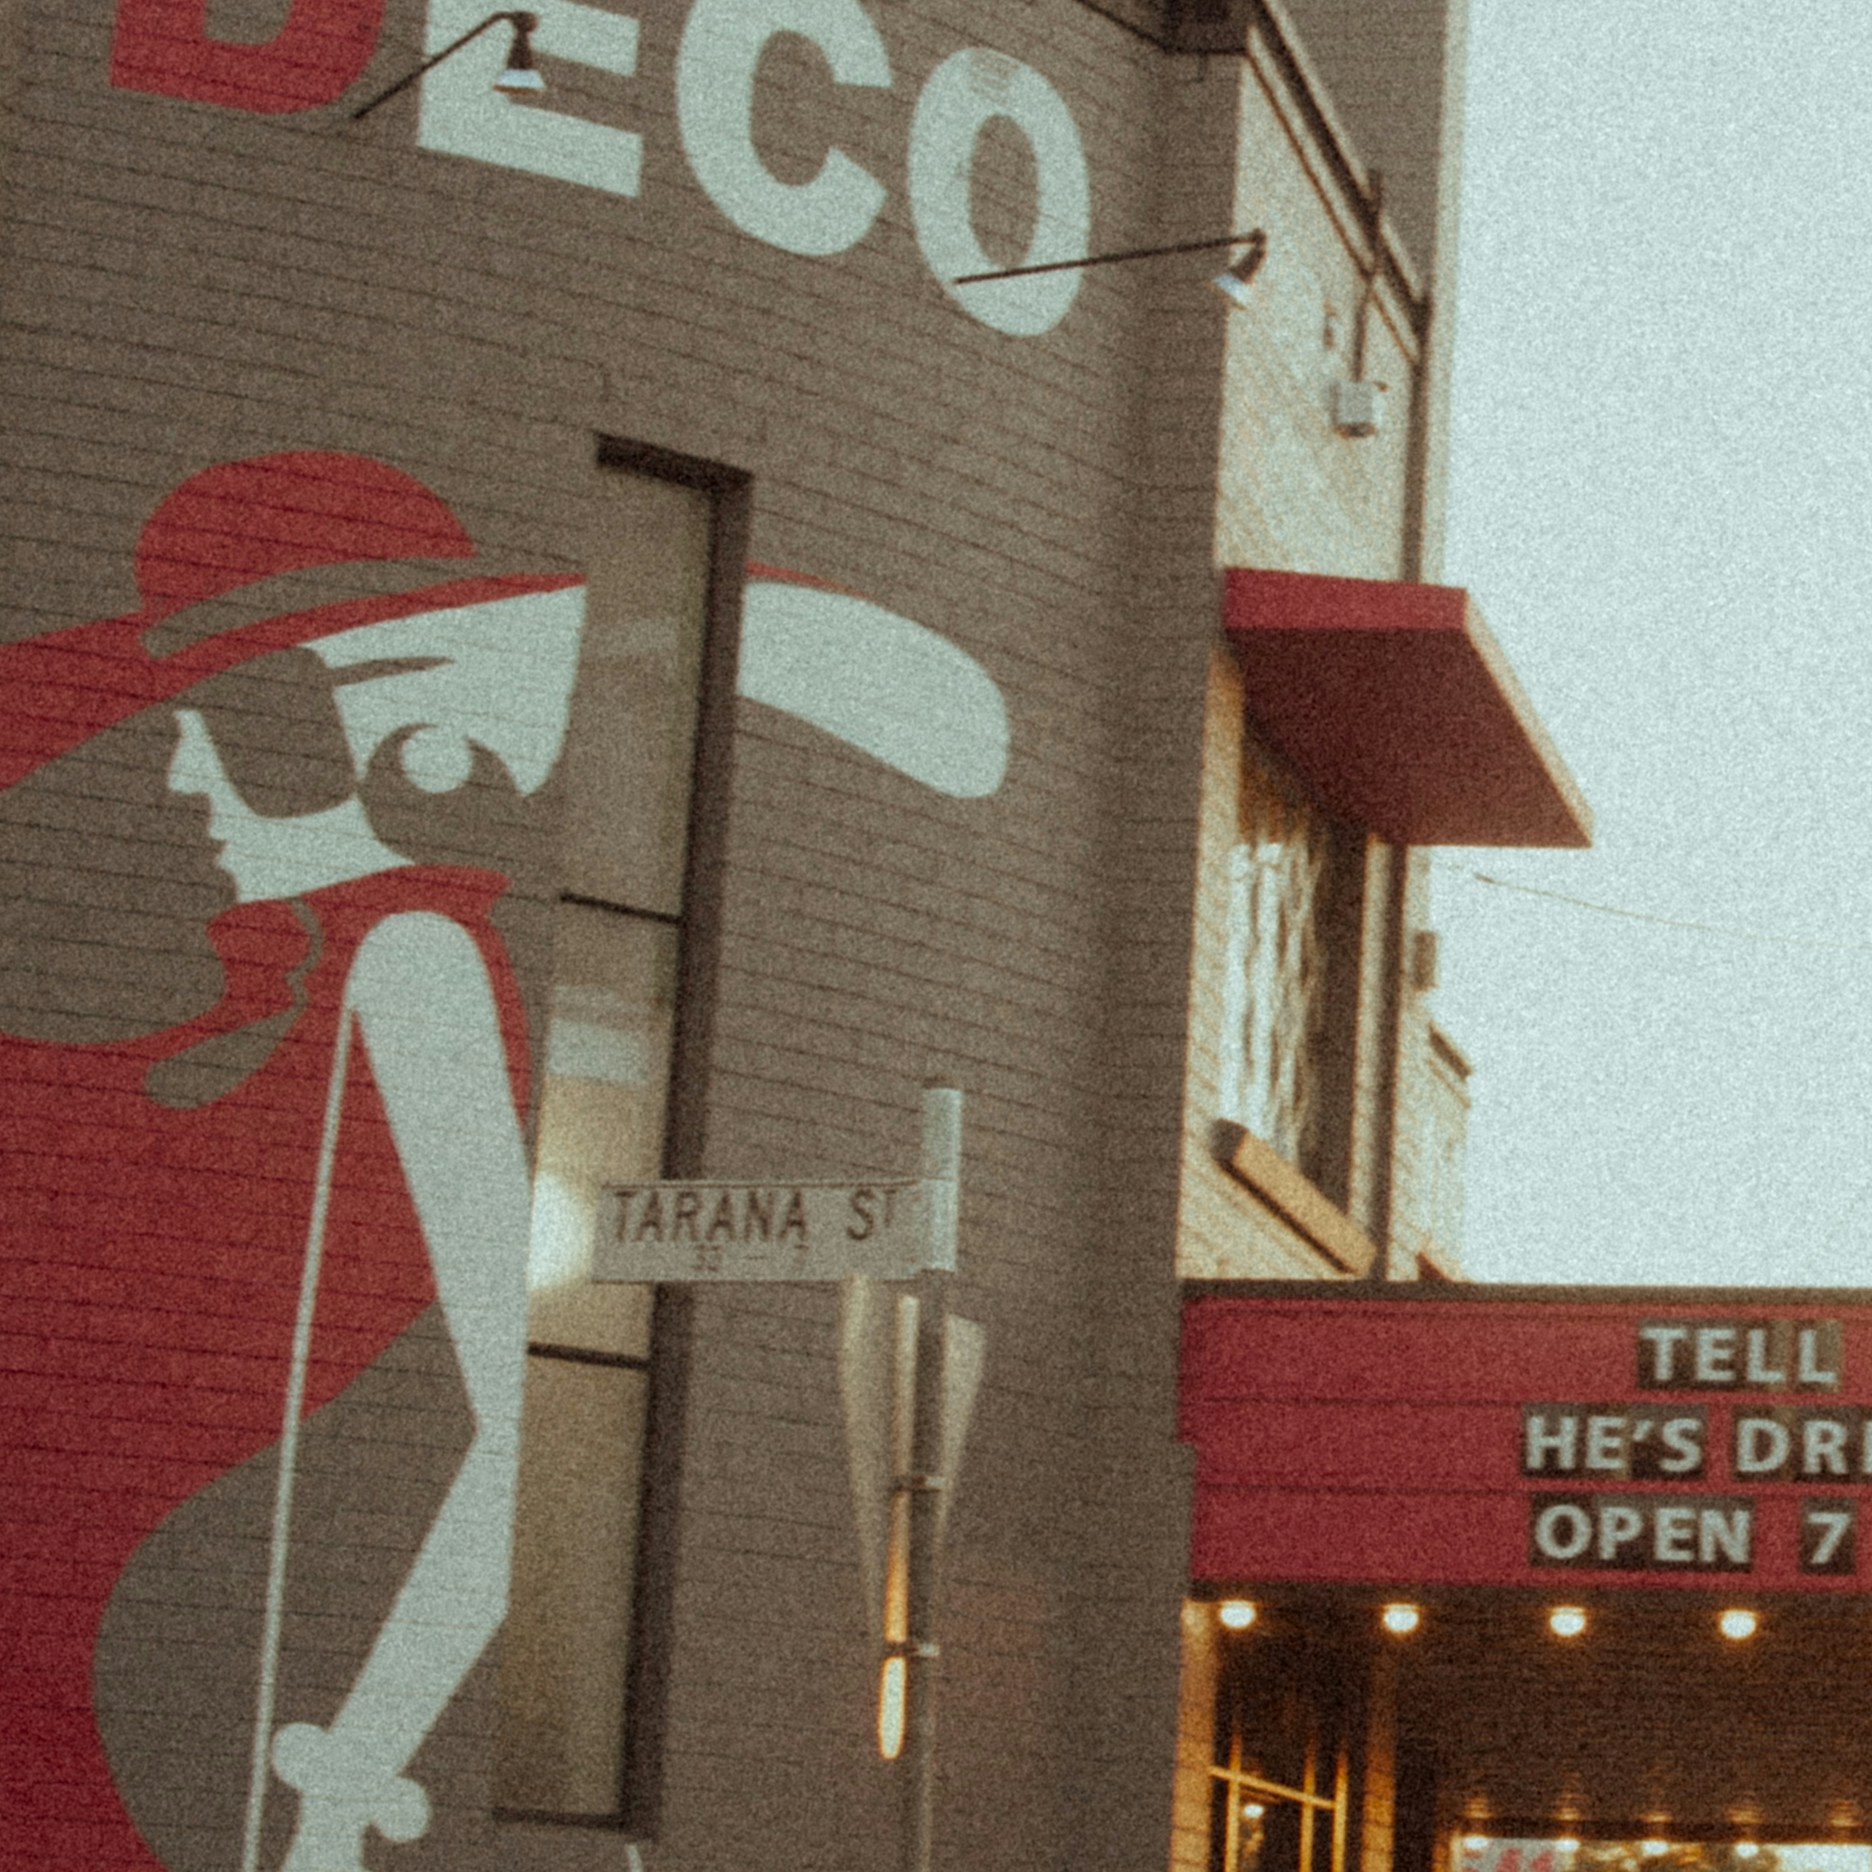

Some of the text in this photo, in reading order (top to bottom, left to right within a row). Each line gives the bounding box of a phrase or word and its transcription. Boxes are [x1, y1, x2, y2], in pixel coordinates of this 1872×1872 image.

[614, 1187, 899, 1243] TARANA ST
[1640, 1327, 1838, 1385] TELL
[1524, 1416, 1703, 1472] HE'S
[1534, 1505, 1753, 1564] OPEN
[1806, 1511, 1852, 1564] 7
